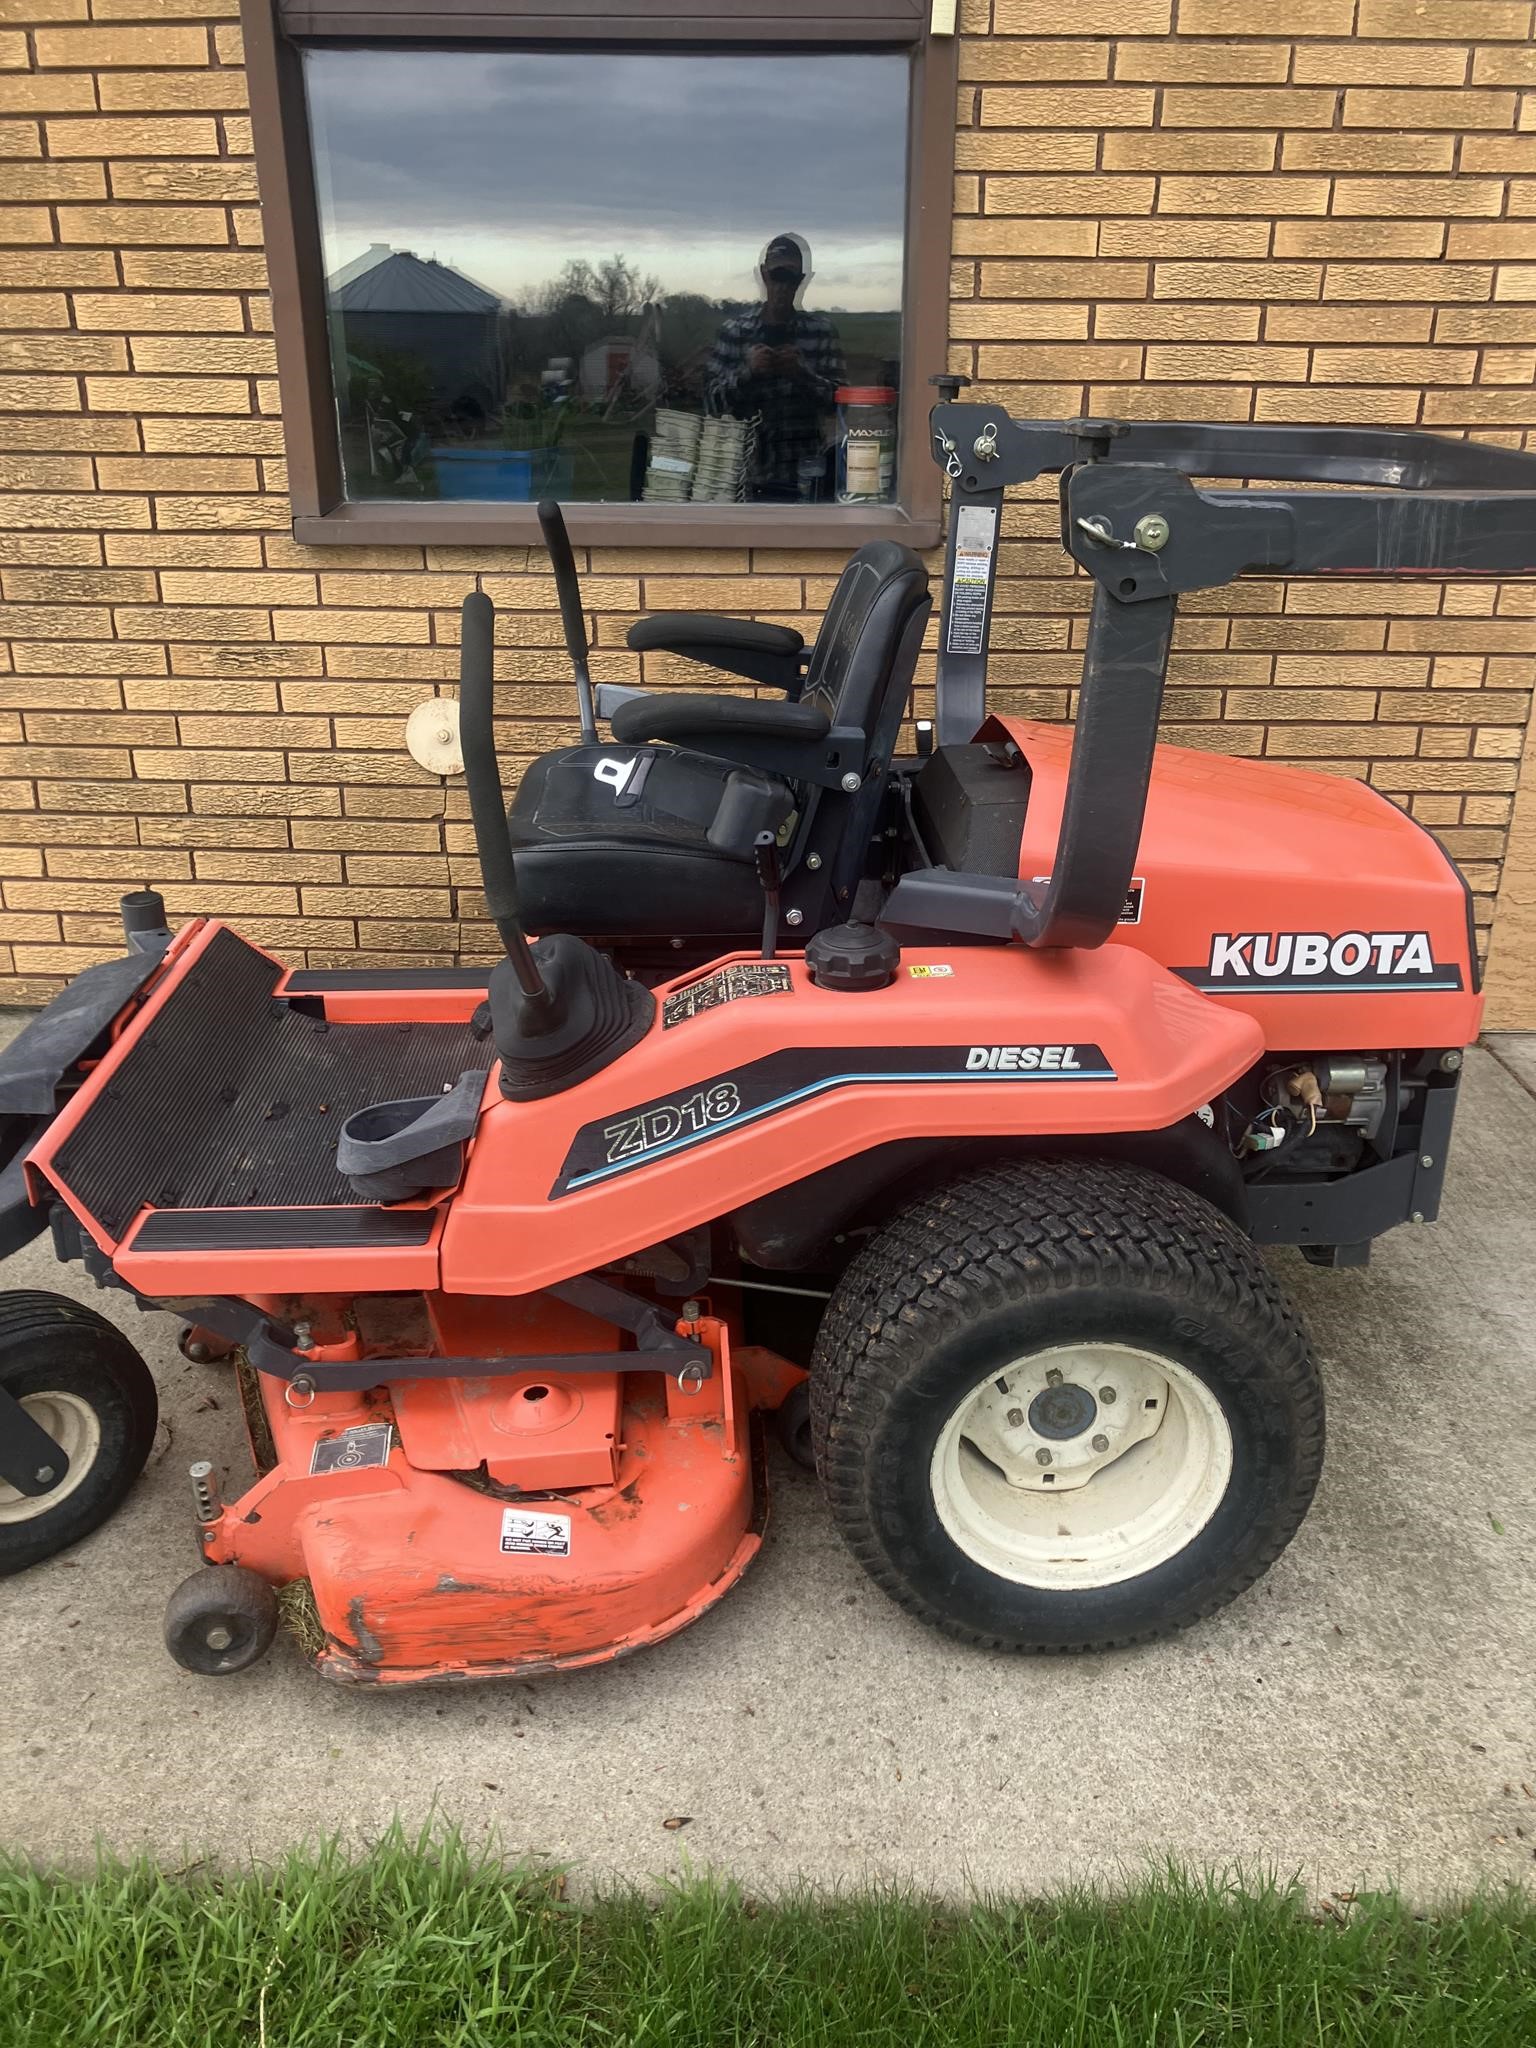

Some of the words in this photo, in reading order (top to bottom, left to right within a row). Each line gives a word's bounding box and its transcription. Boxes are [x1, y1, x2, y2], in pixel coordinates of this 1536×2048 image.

[1210, 933, 1434, 977] KUBOTA
[965, 1046, 1081, 1071] DIESEL
[603, 1082, 741, 1163] ZD18
